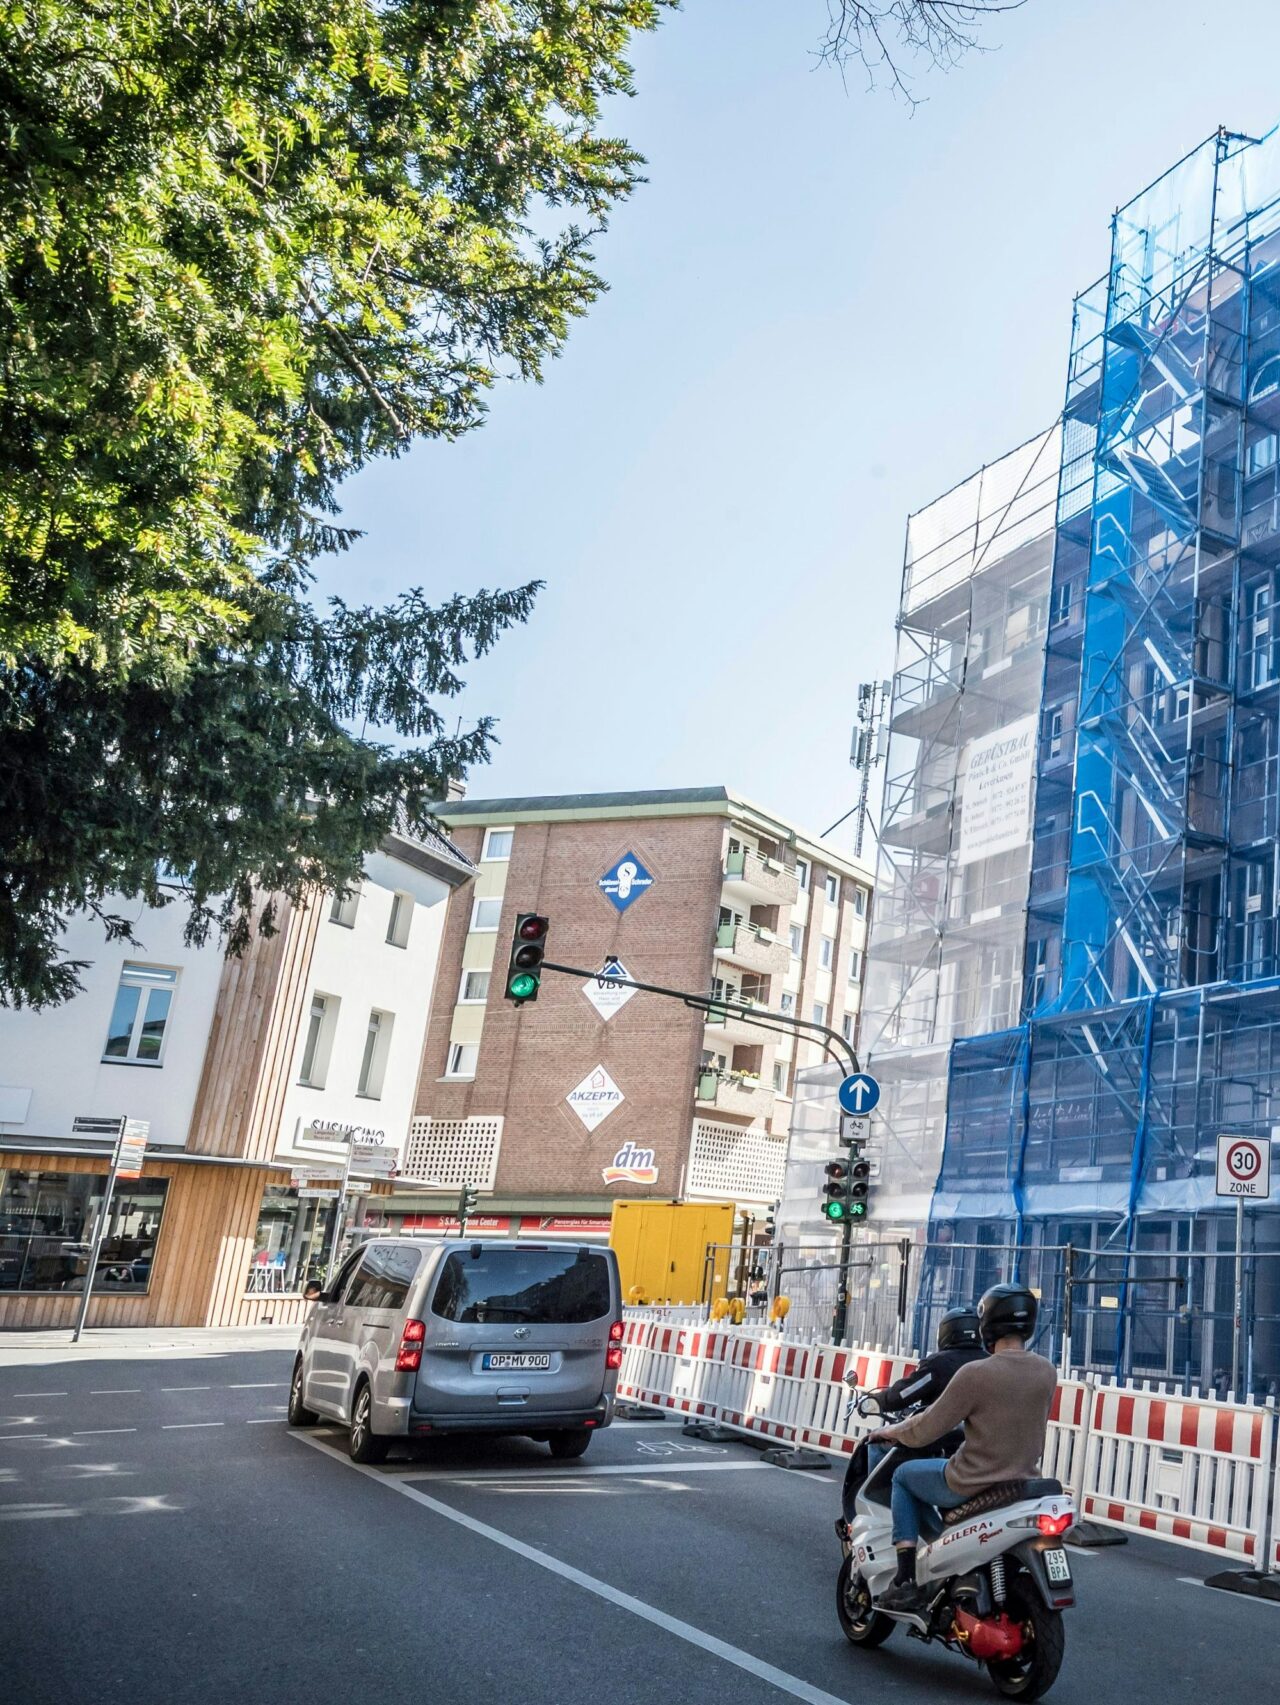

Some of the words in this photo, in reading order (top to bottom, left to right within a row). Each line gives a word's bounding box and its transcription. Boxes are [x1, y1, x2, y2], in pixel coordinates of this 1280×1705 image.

[569, 1091, 620, 1101] AKZEPTA
[615, 1144, 652, 1168] dm
[1233, 1151, 1254, 1171] 30
[1229, 1182, 1257, 1194] ZONE
[480, 1216, 499, 1226] Center
[490, 1354, 506, 1367] OP
[511, 1355, 528, 1367] MV
[528, 1355, 549, 1367] 900
[942, 1522, 988, 1546] GILERA
